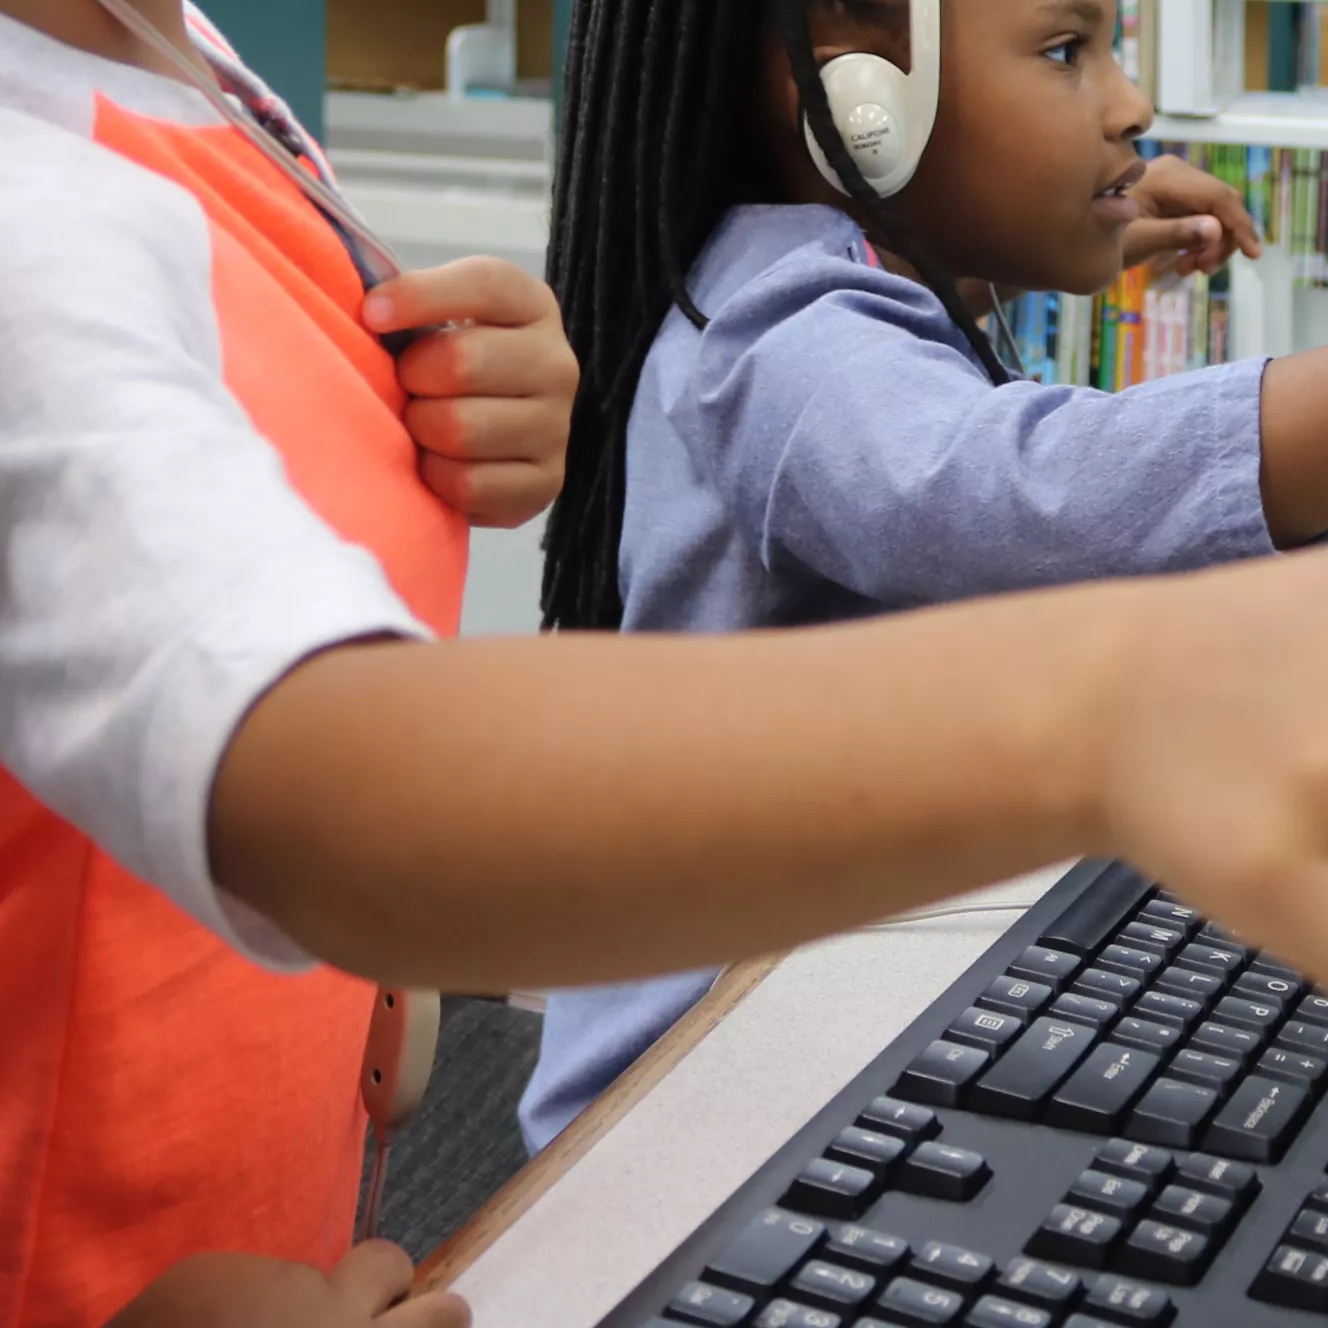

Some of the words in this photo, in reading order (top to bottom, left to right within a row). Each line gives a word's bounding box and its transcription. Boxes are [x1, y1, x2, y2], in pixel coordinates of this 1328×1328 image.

[1172, 907, 1192, 918] N
[1151, 929, 1172, 941] M
[1209, 951, 1232, 962] K
[1190, 974, 1211, 983] L
[1267, 981, 1288, 991] O
[1250, 1004, 1269, 1016] P
[1042, 1035, 1063, 1051] Shift
[1104, 1062, 1124, 1079] Enter
[1243, 1097, 1275, 1129] Backspace
[958, 1253, 979, 1267] 4
[840, 1272, 865, 1289] 2
[1046, 1268, 1071, 1285] 7
[924, 1291, 950, 1307] 5
[805, 1312, 830, 1328] 3
